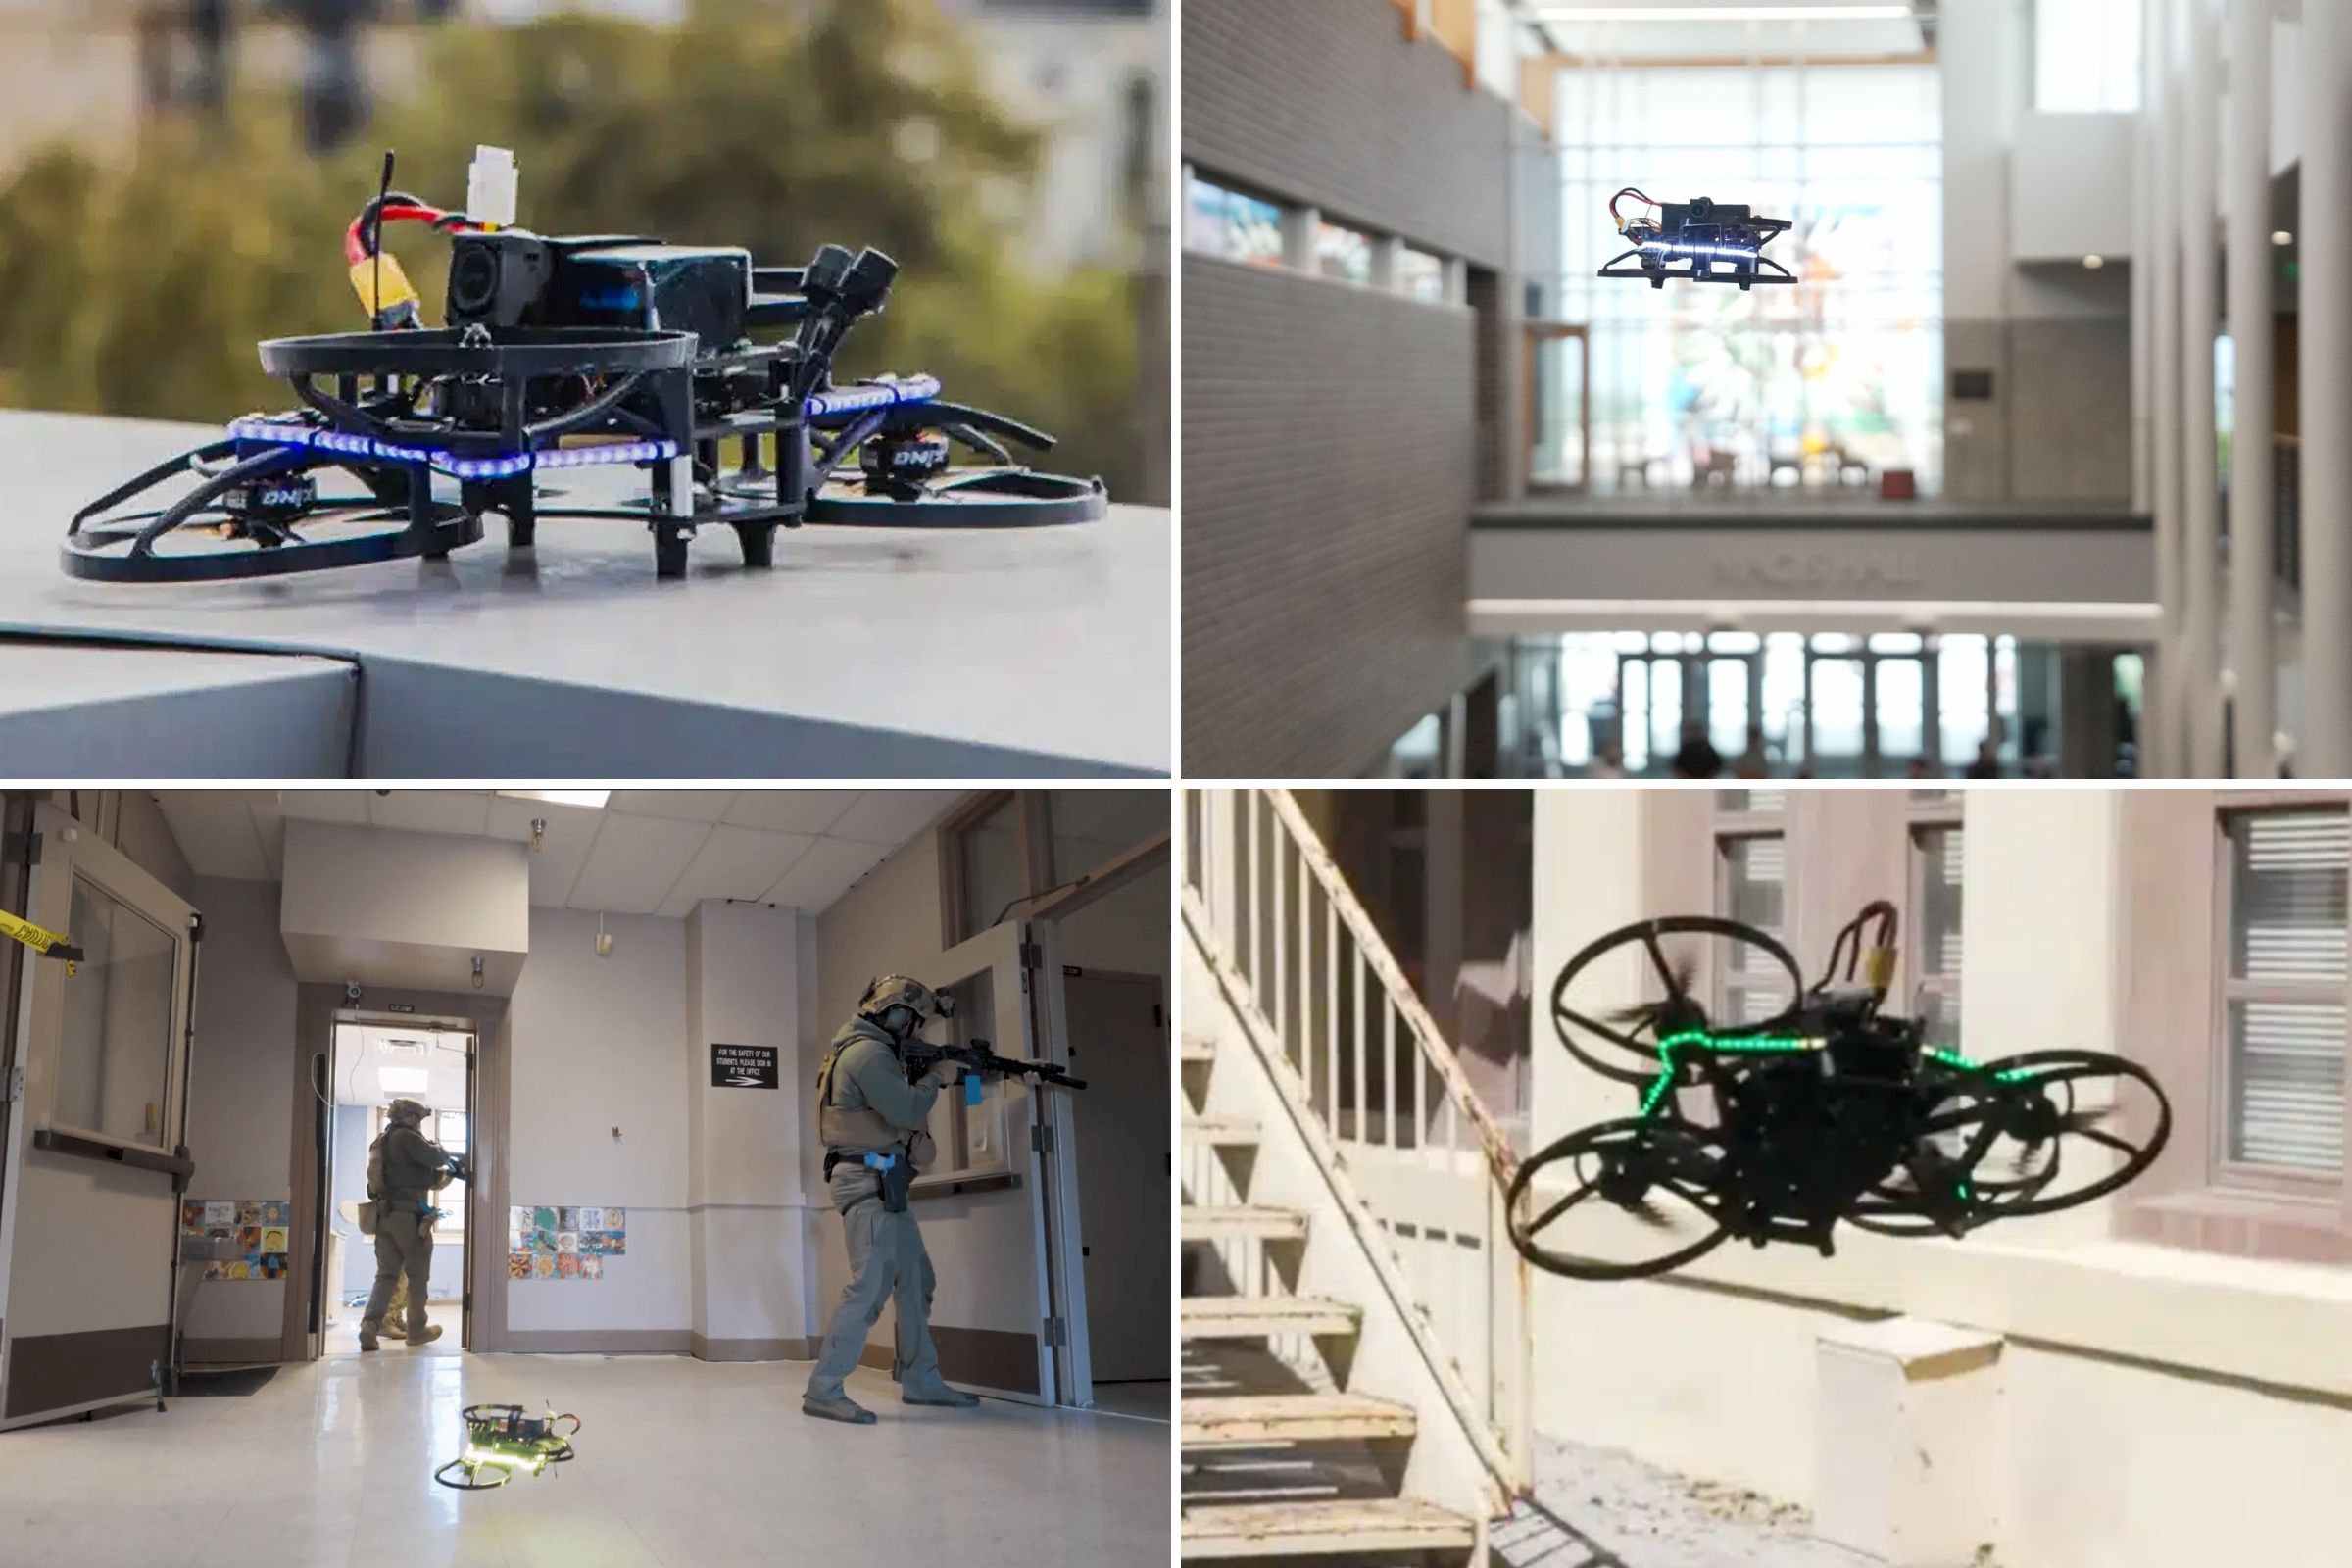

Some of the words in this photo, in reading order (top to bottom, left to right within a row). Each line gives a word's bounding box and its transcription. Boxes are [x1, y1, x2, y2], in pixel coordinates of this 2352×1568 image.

[738, 1049, 754, 1057] SAFETY
[739, 1058, 756, 1067] PLEASE
[746, 1067, 761, 1076] OFFICE
